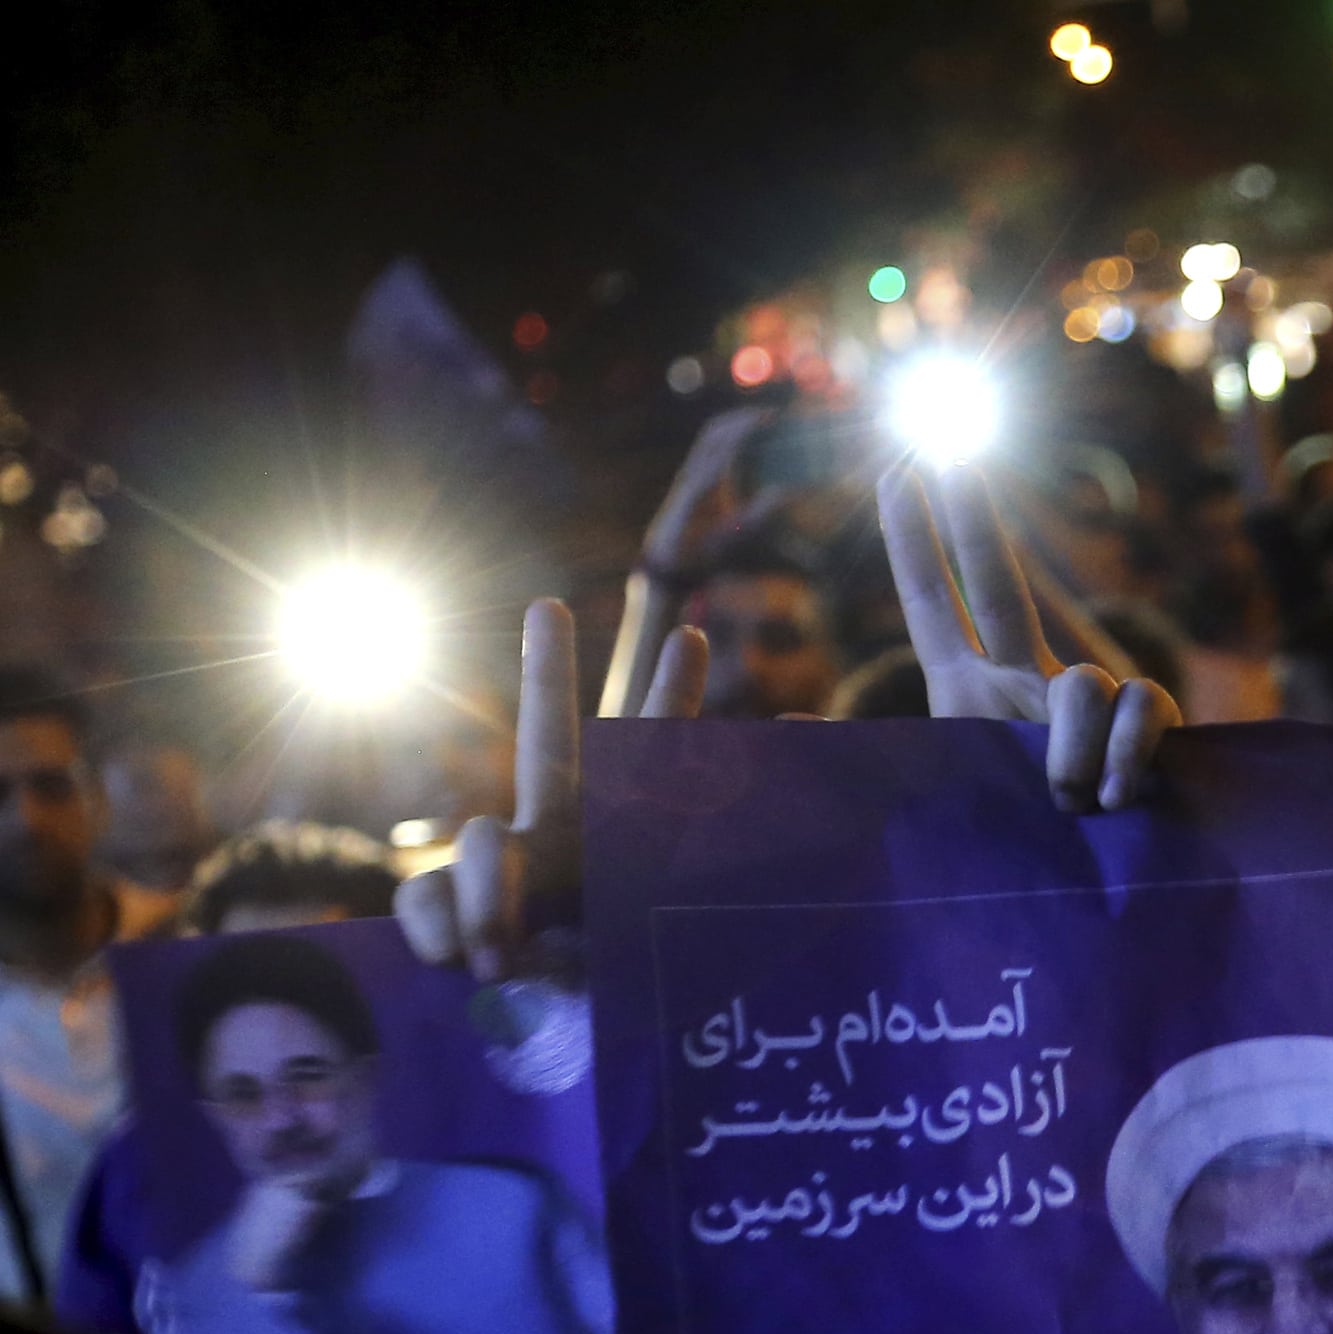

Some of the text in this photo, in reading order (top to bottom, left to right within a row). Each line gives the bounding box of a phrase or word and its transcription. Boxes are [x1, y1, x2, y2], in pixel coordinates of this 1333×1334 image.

[682, 996, 825, 1069] برای
[685, 1046, 1073, 1157] آزادی بیشتر
[690, 1152, 1077, 1244] در این سرزمین
